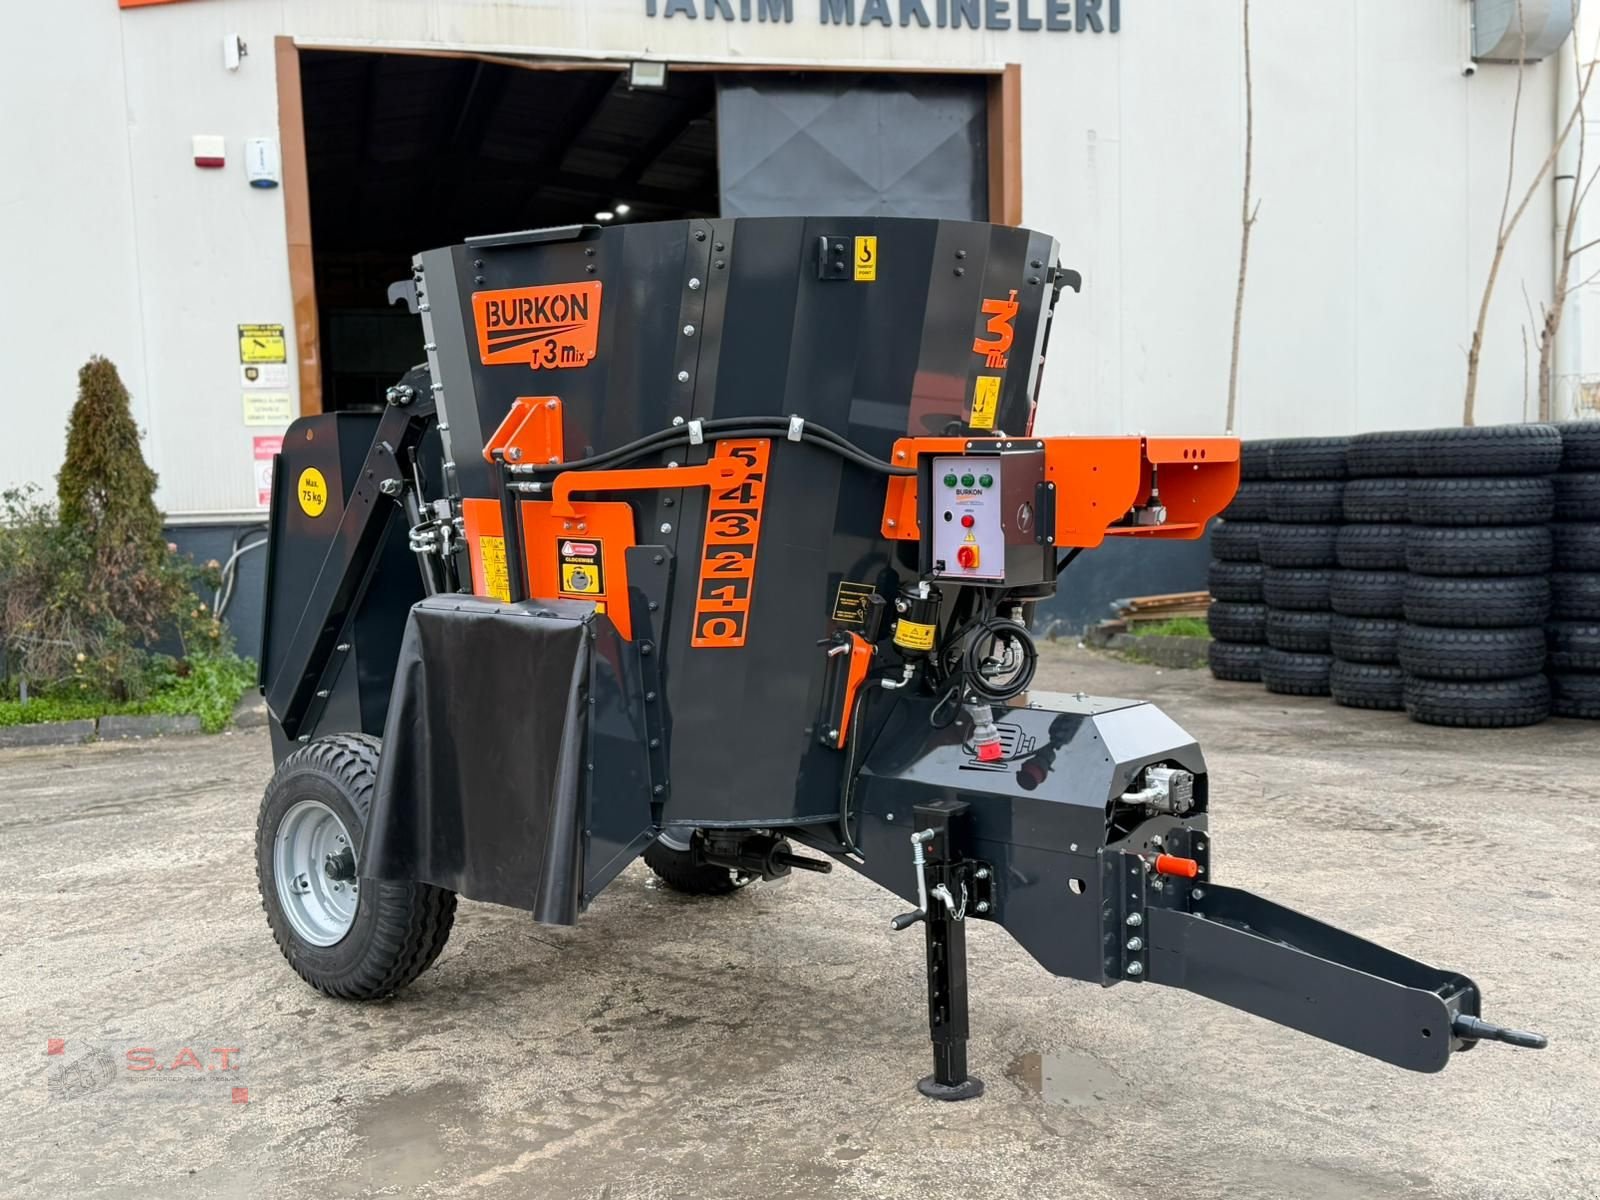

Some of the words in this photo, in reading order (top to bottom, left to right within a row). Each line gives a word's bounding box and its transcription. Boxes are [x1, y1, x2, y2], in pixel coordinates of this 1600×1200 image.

[486, 293, 588, 327] BURKON
[305, 478, 319, 488] Max.
[955, 488, 983, 496] BURKON
[302, 490, 312, 501] 75
[713, 514, 751, 537] 3
[713, 551, 745, 572] 2
[710, 585, 737, 606] 1
